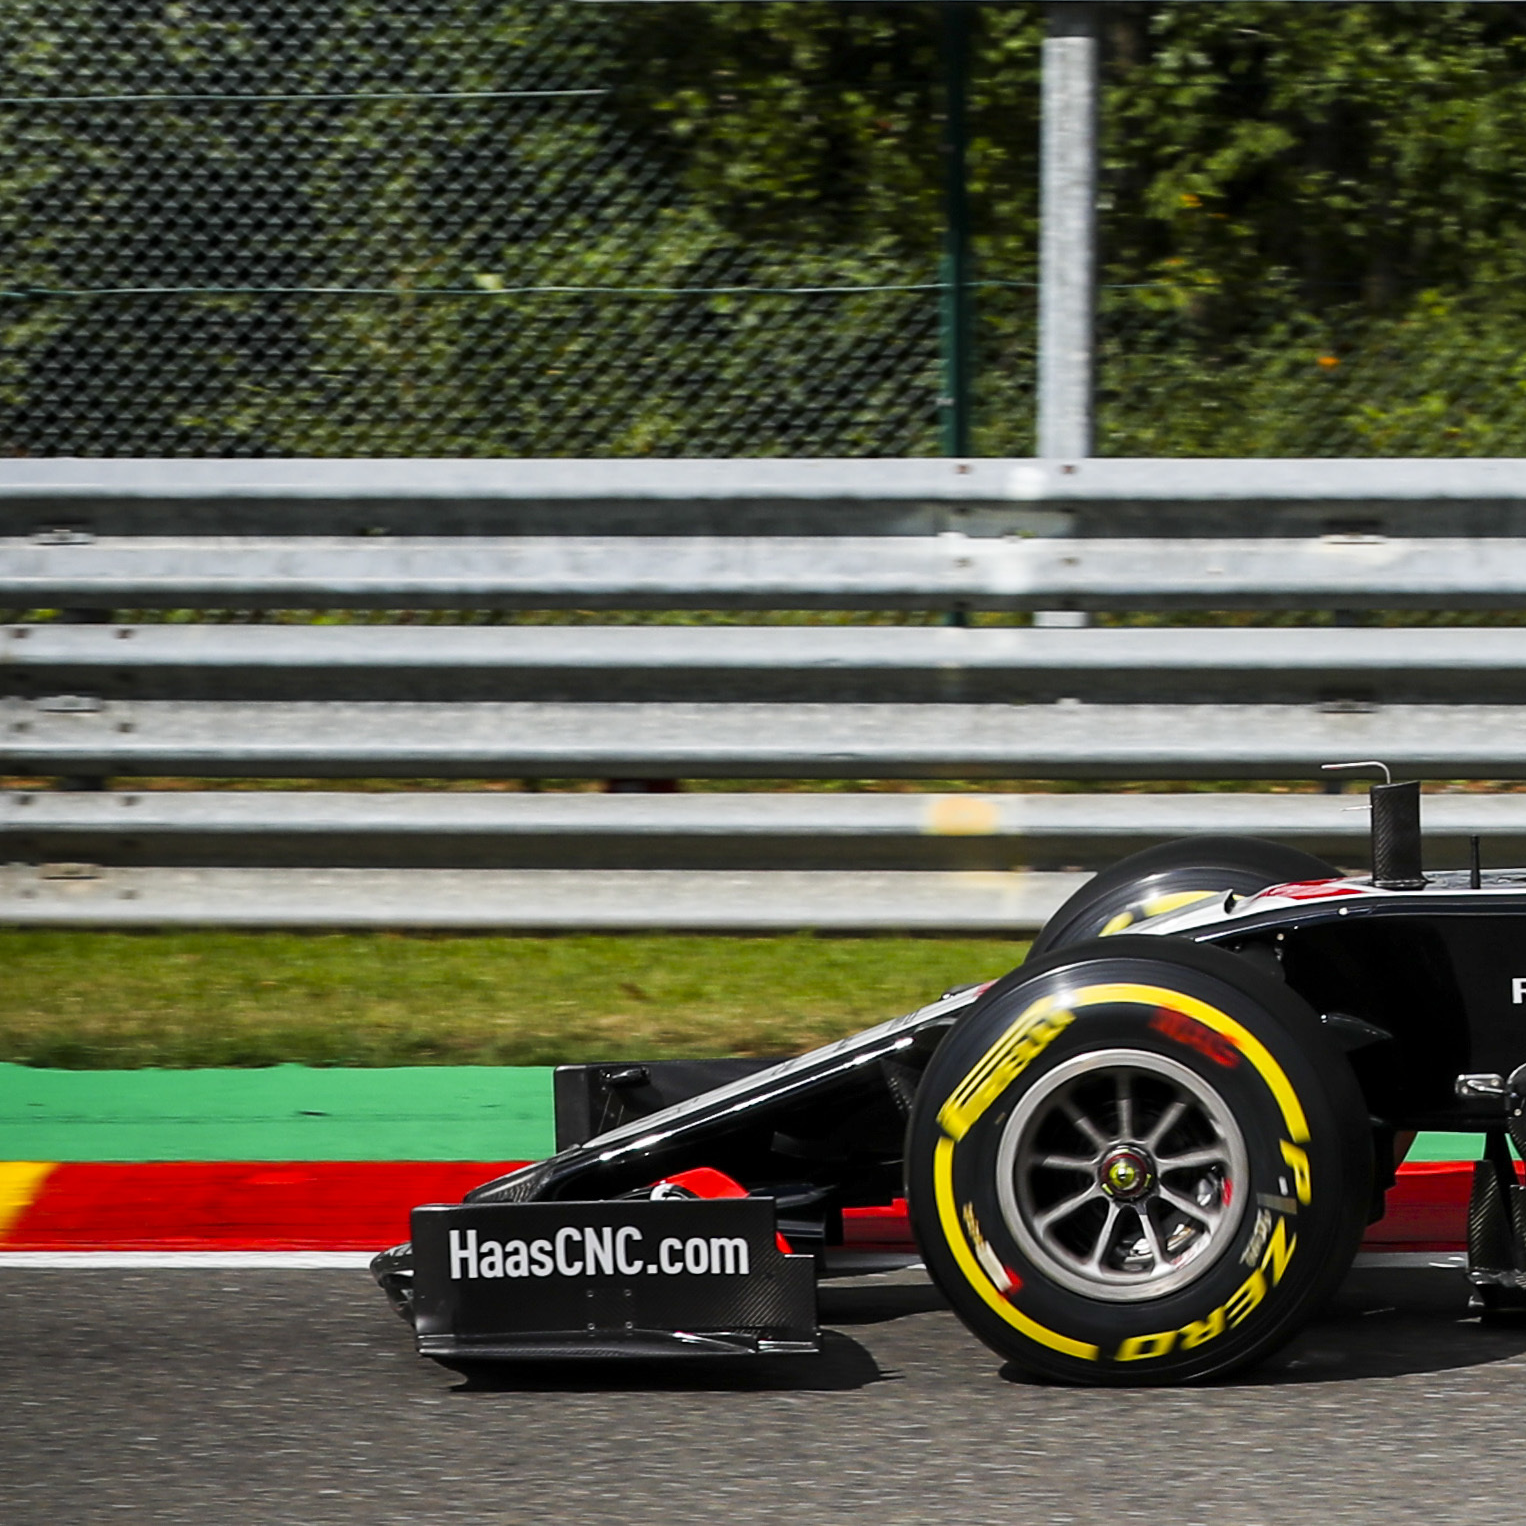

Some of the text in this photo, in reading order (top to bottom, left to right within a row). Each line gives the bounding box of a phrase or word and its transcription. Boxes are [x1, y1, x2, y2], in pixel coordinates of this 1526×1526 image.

[449, 1225, 750, 1280] HaasCNC.com
[1114, 1138, 1312, 1362] P ZERO
